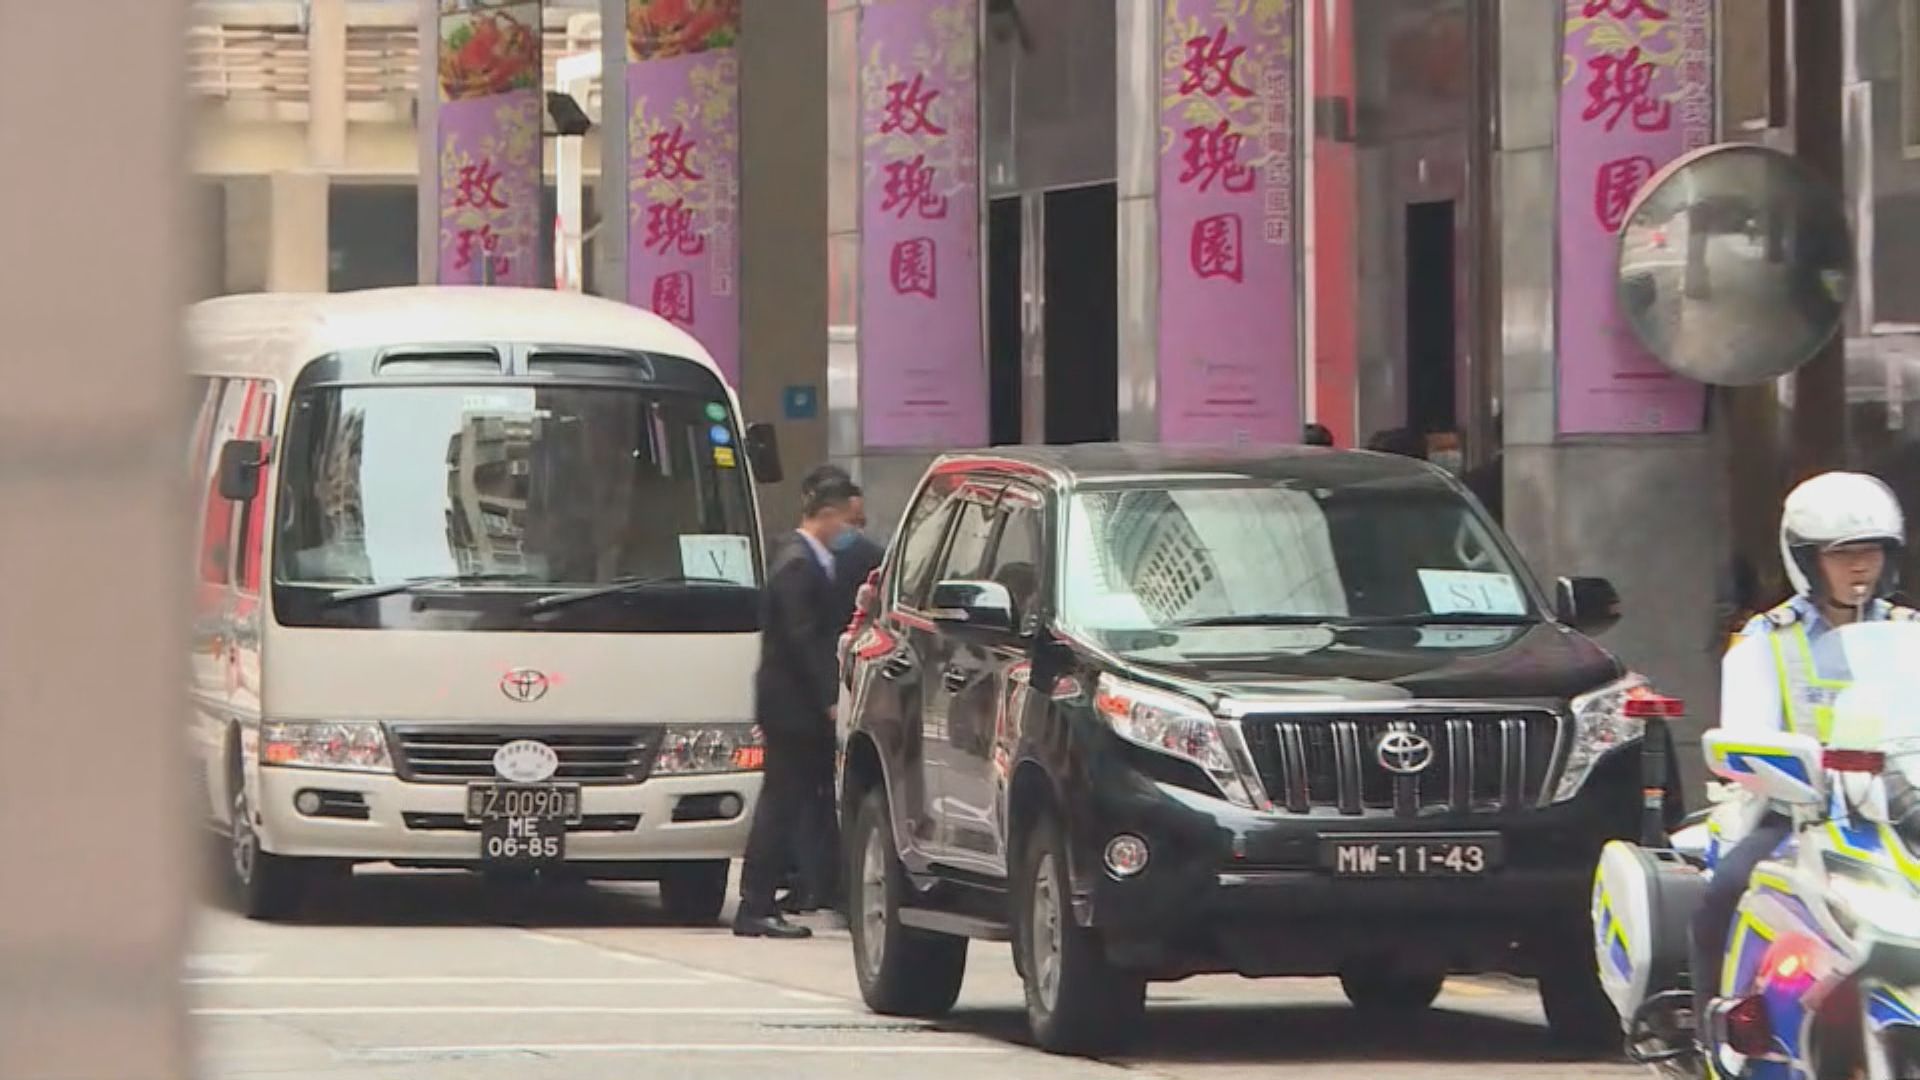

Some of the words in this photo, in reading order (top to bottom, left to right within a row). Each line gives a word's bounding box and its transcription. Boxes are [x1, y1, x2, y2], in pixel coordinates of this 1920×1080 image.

[880, 72, 947, 299] 玫瑰園
[1178, 24, 1256, 284] 玫瑰園
[1582, 0, 1670, 233] 瑰園
[644, 124, 705, 326] 玫瑰園
[488, 836, 558, 857] 06-85
[508, 817, 539, 837] ME
[1337, 845, 1484, 872] MW-11-43
